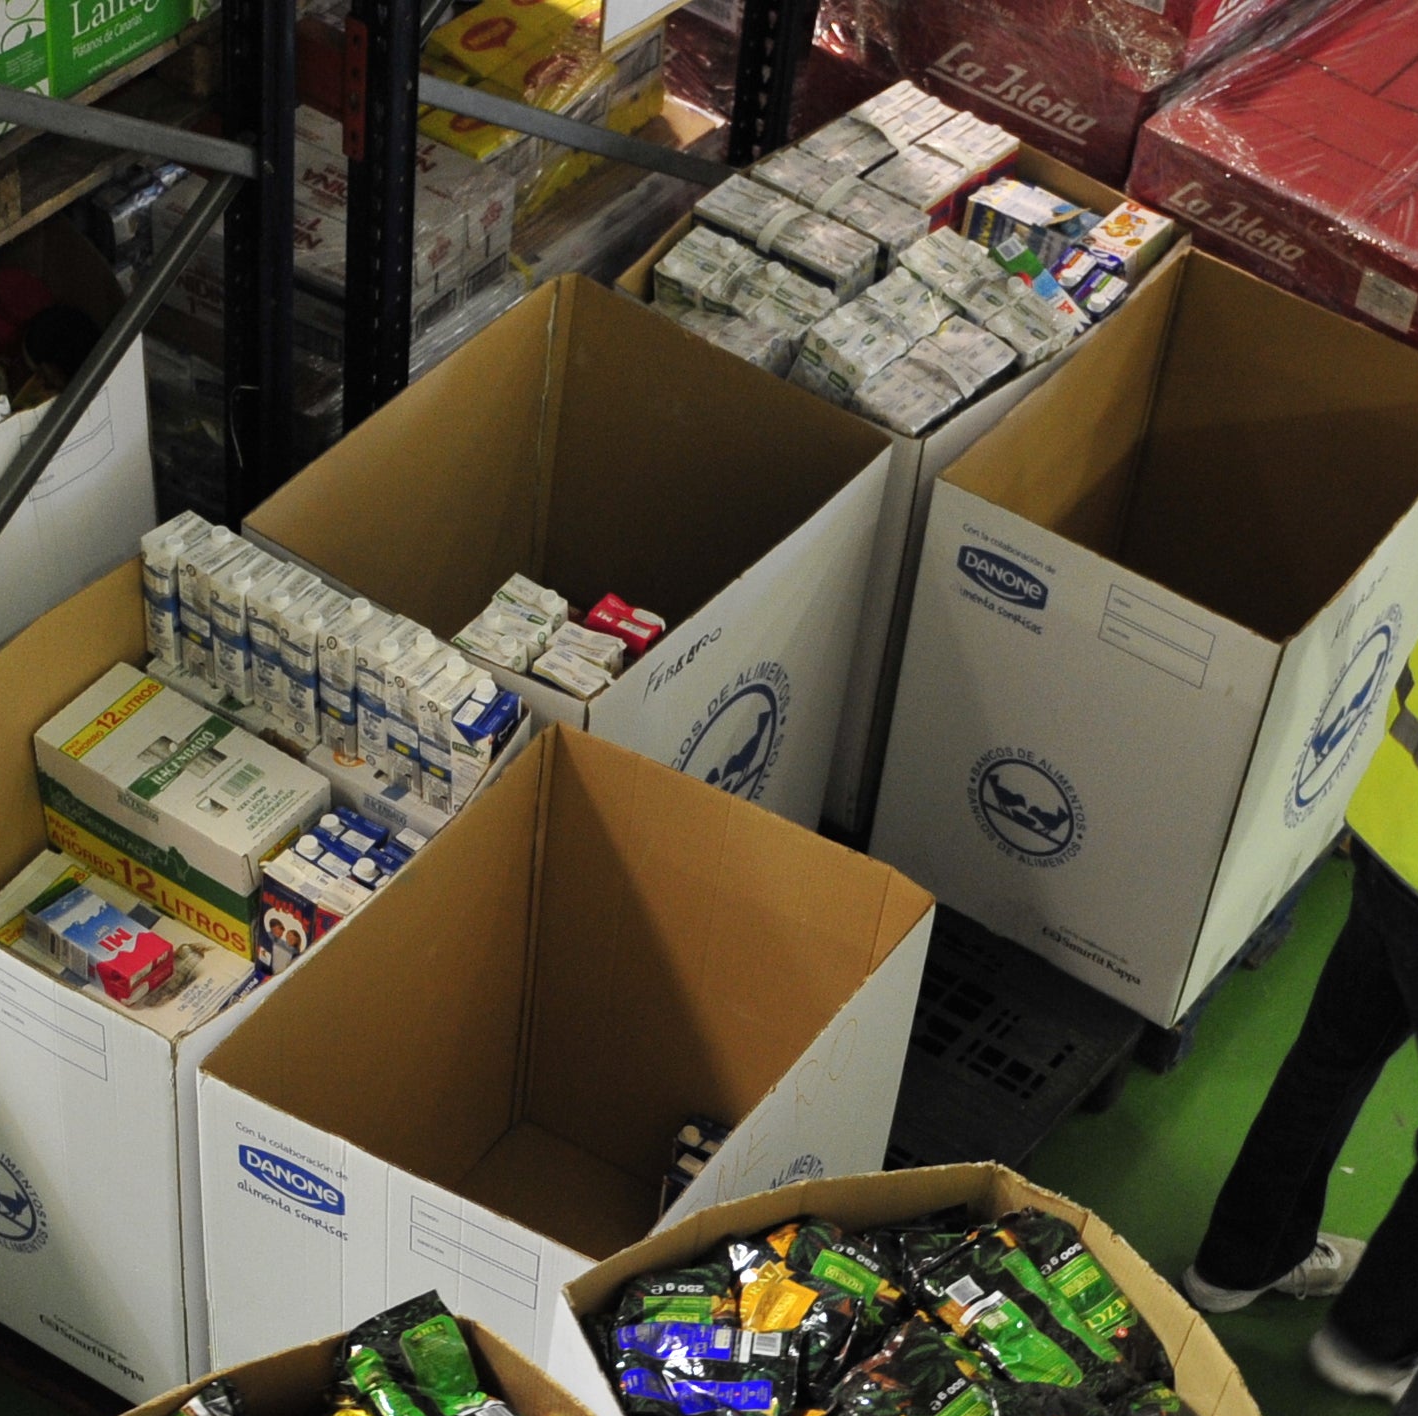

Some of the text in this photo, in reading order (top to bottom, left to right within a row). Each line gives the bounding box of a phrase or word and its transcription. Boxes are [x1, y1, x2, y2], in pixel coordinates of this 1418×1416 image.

[937, 41, 979, 83] La
[1167, 181, 1205, 214] La
[962, 523, 979, 537] Con
[990, 537, 1044, 571] colaboración
[1045, 561, 1056, 575] de
[965, 551, 1042, 600] DANONE
[96, 682, 160, 732] 12 LITROS
[708, 684, 729, 716] DE
[72, 730, 105, 756] AHORRO
[972, 747, 1086, 832] BANCOS DE ALIMENTOS
[48, 814, 78, 838] PACK
[51, 829, 115, 875] AHORRO
[1018, 841, 1081, 868] ALIMENTOS
[117, 856, 157, 900] 12
[161, 889, 247, 953] LITROS
[235, 1121, 348, 1181] Con la colaboración de
[246, 1150, 338, 1206] DANONE
[237, 1180, 291, 1214] alimenta
[857, 1253, 880, 1272] 250
[1060, 1243, 1083, 1261] 500
[677, 1284, 704, 1293] 250
[107, 1354, 144, 1382] Kappa
[947, 1378, 966, 1396] 500
